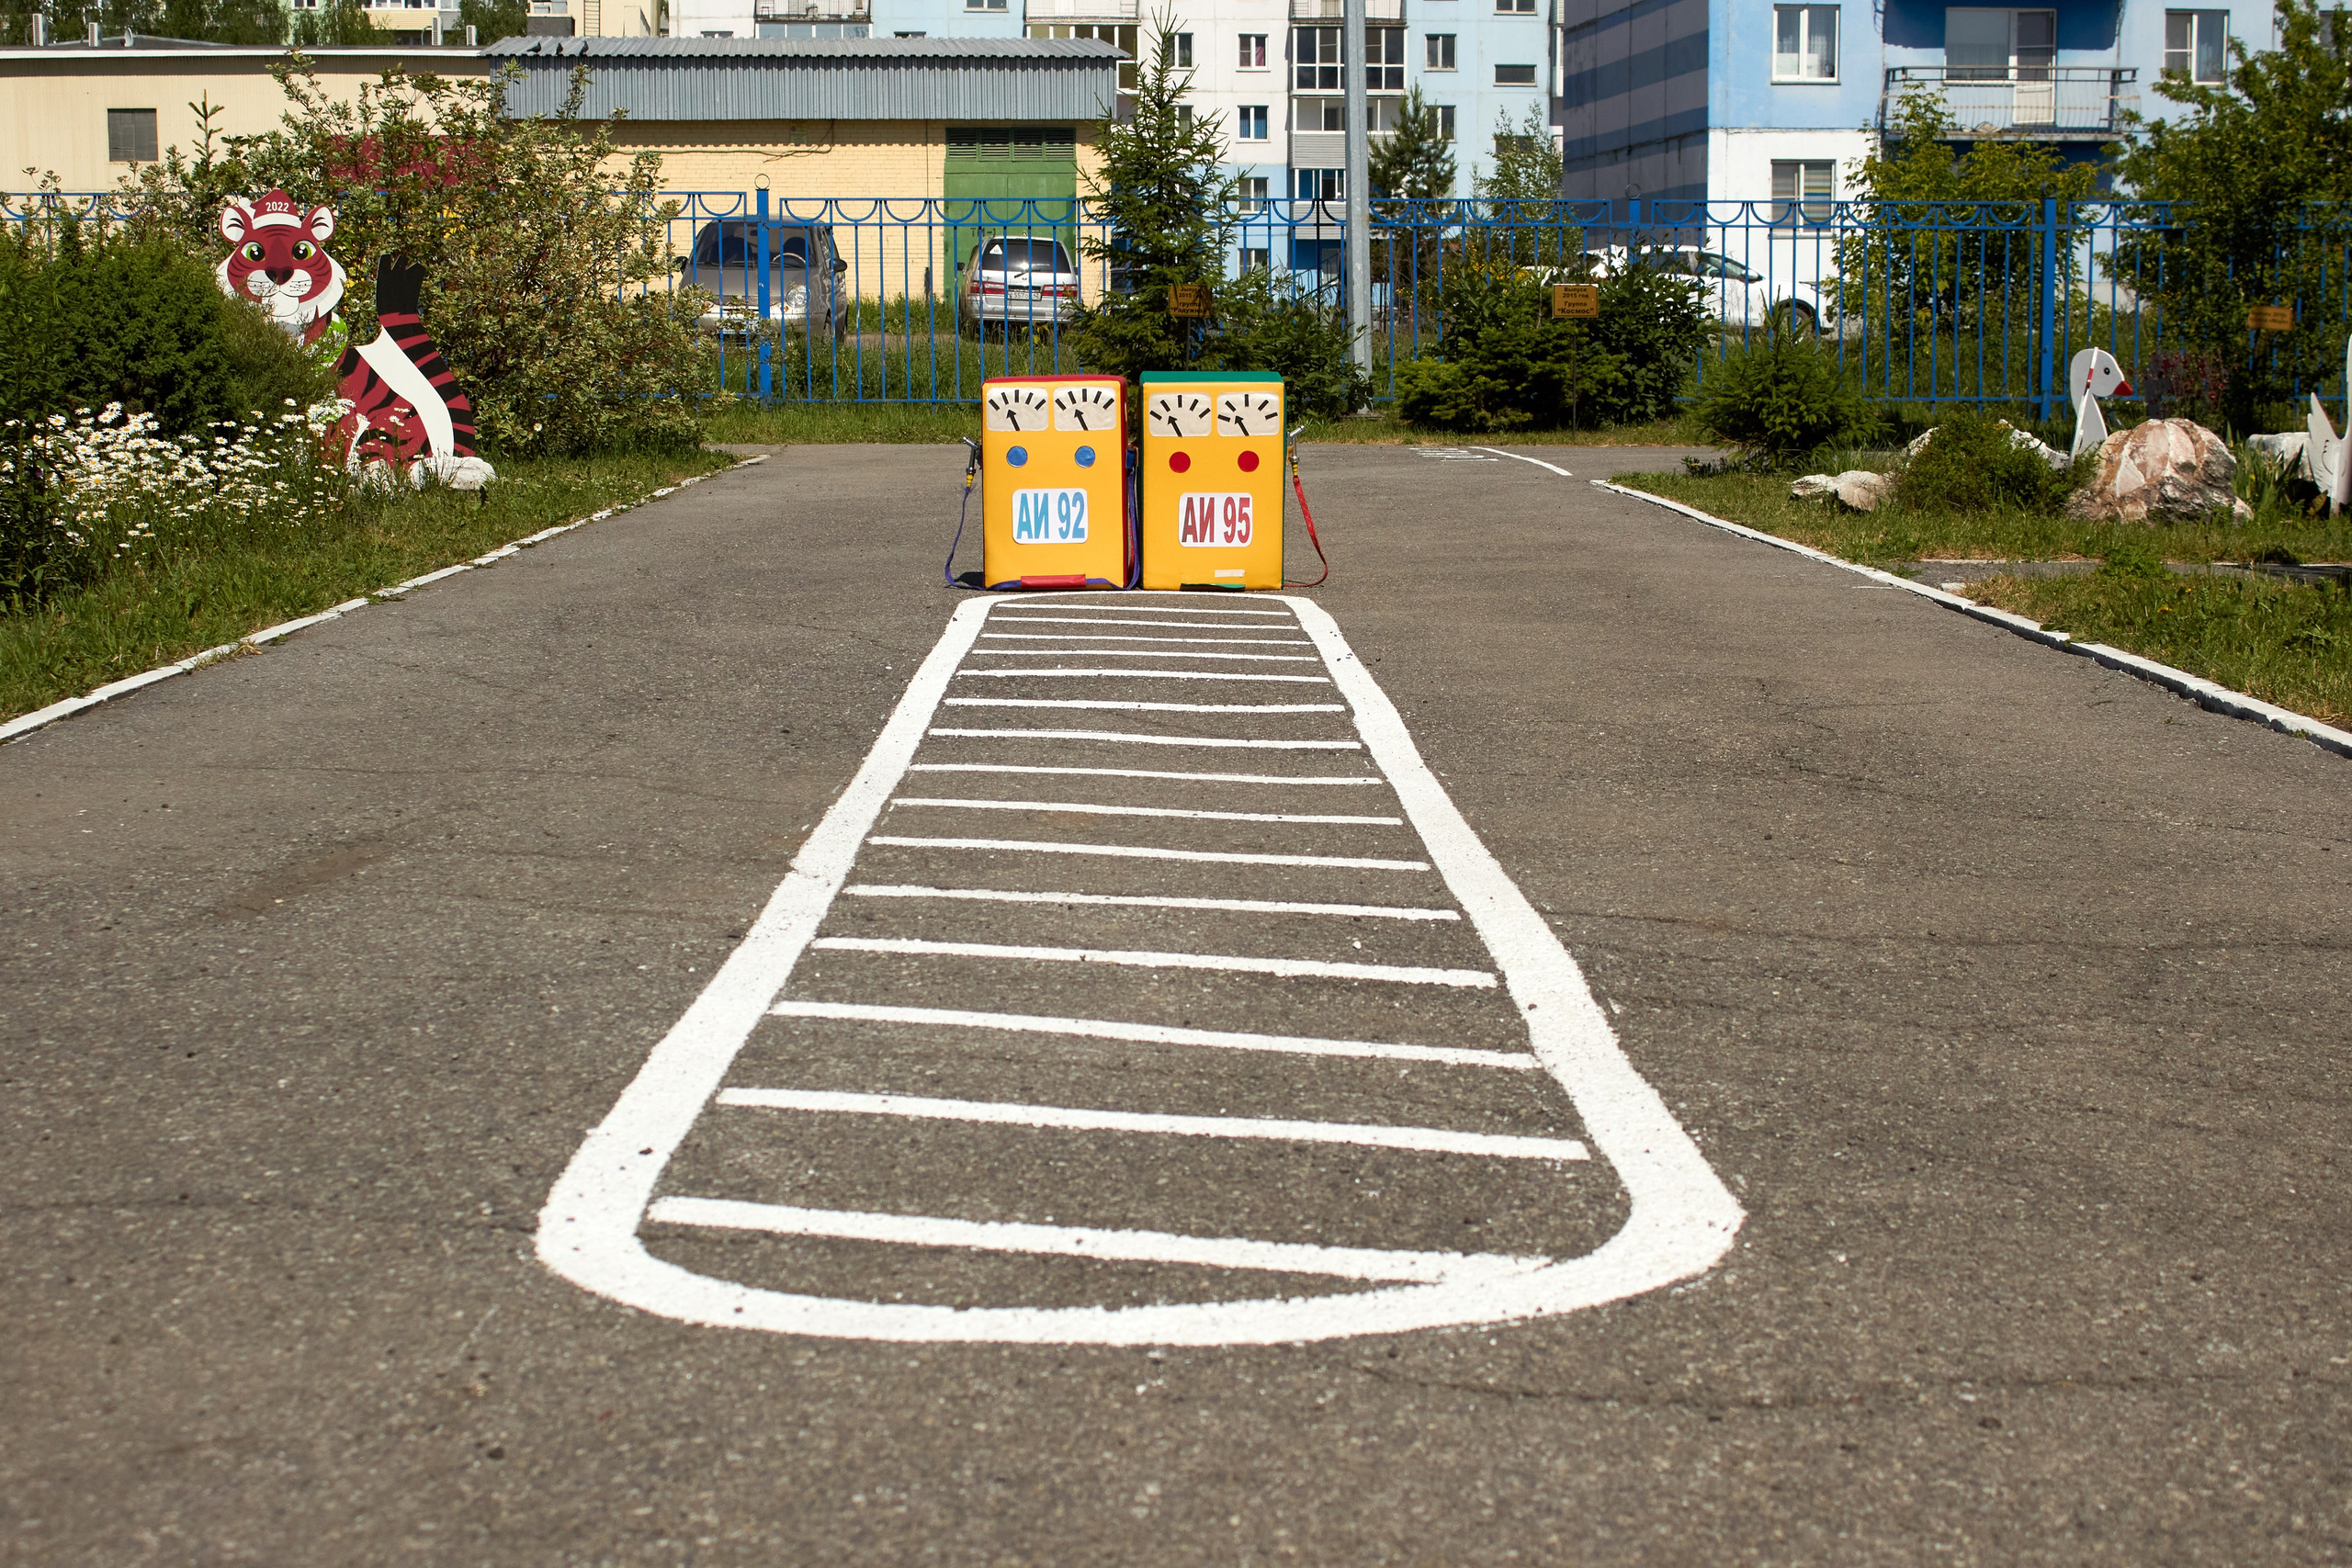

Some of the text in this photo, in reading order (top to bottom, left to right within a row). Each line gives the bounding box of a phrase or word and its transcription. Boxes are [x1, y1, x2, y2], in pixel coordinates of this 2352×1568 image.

[266, 201, 289, 212] 2022
[1016, 491, 1085, 539] АИ 92
[1182, 496, 1250, 544] АИ 95
